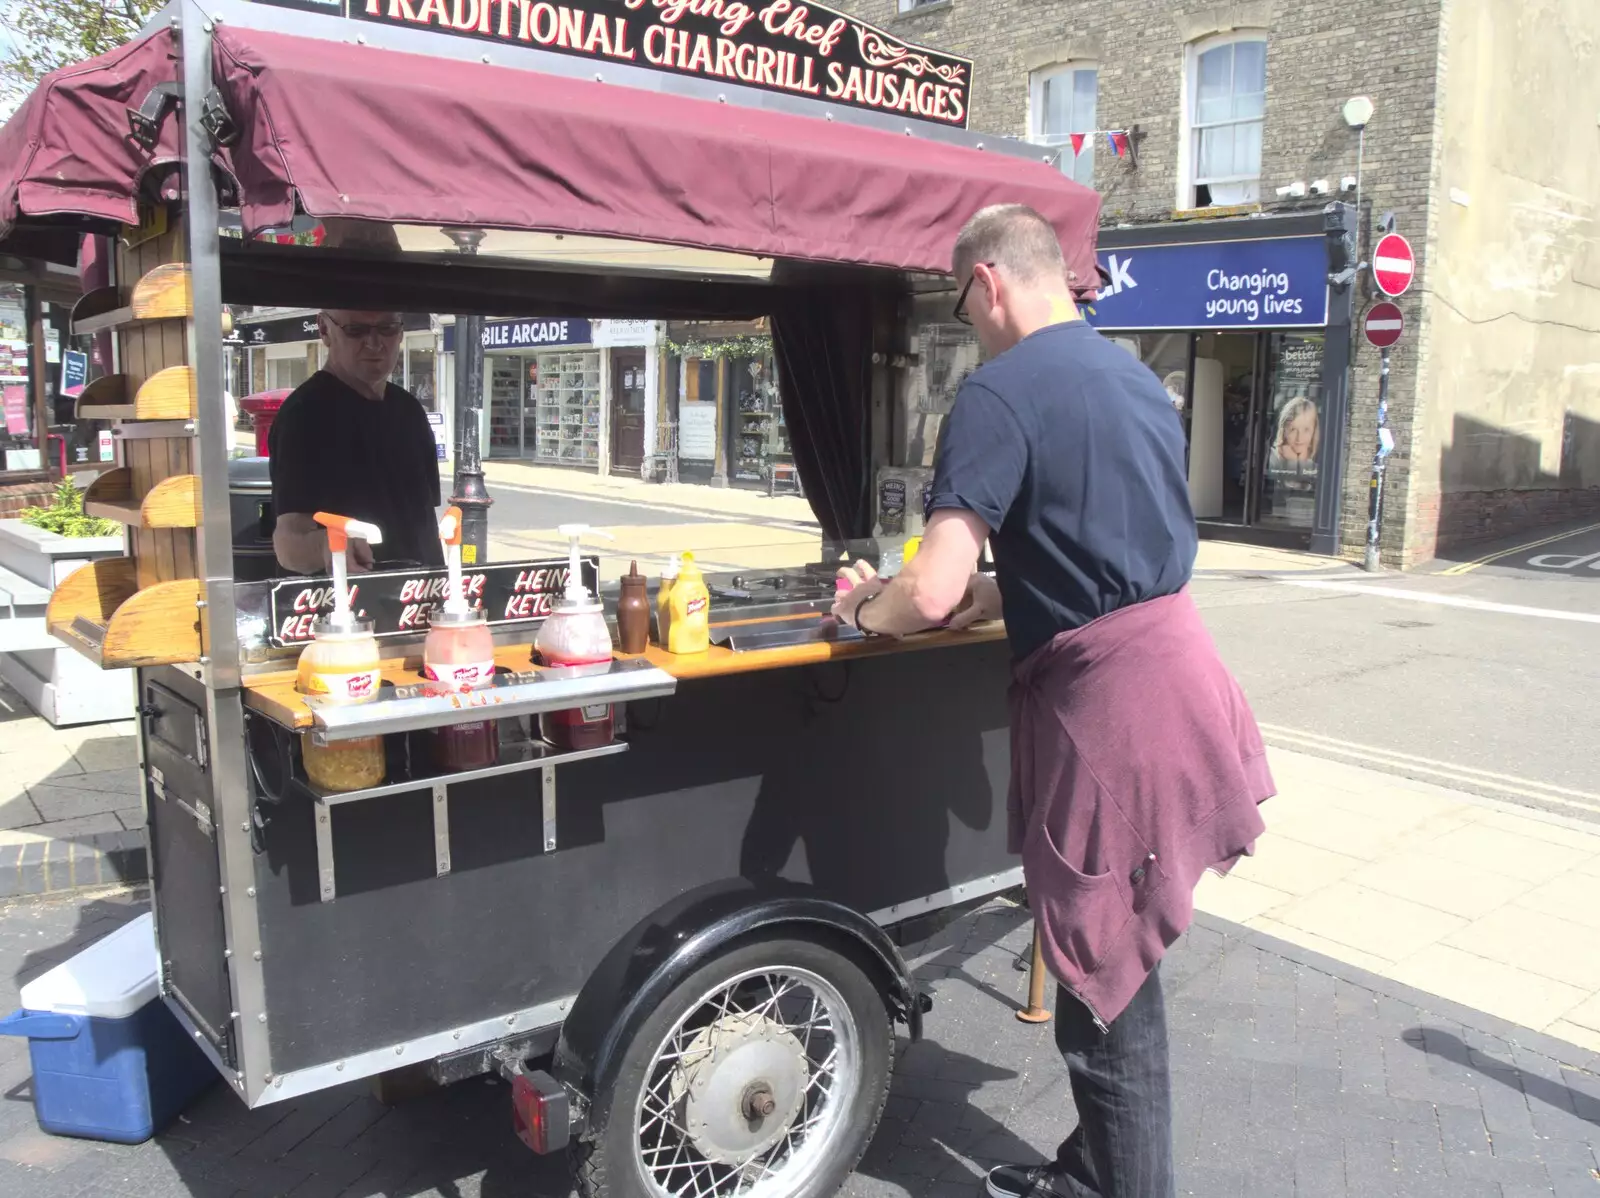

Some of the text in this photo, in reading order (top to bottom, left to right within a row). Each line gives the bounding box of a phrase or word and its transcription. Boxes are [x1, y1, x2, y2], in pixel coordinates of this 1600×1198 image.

[625, 0, 847, 56] ying Chef
[643, 24, 820, 94] CHARGRILL
[826, 61, 966, 122] SAUSAGES
[1207, 268, 1289, 295] Changing
[1206, 294, 1303, 321] young lives
[482, 321, 568, 346] BILE ARCADE
[1285, 349, 1316, 360] better
[885, 482, 905, 491] HEINZ
